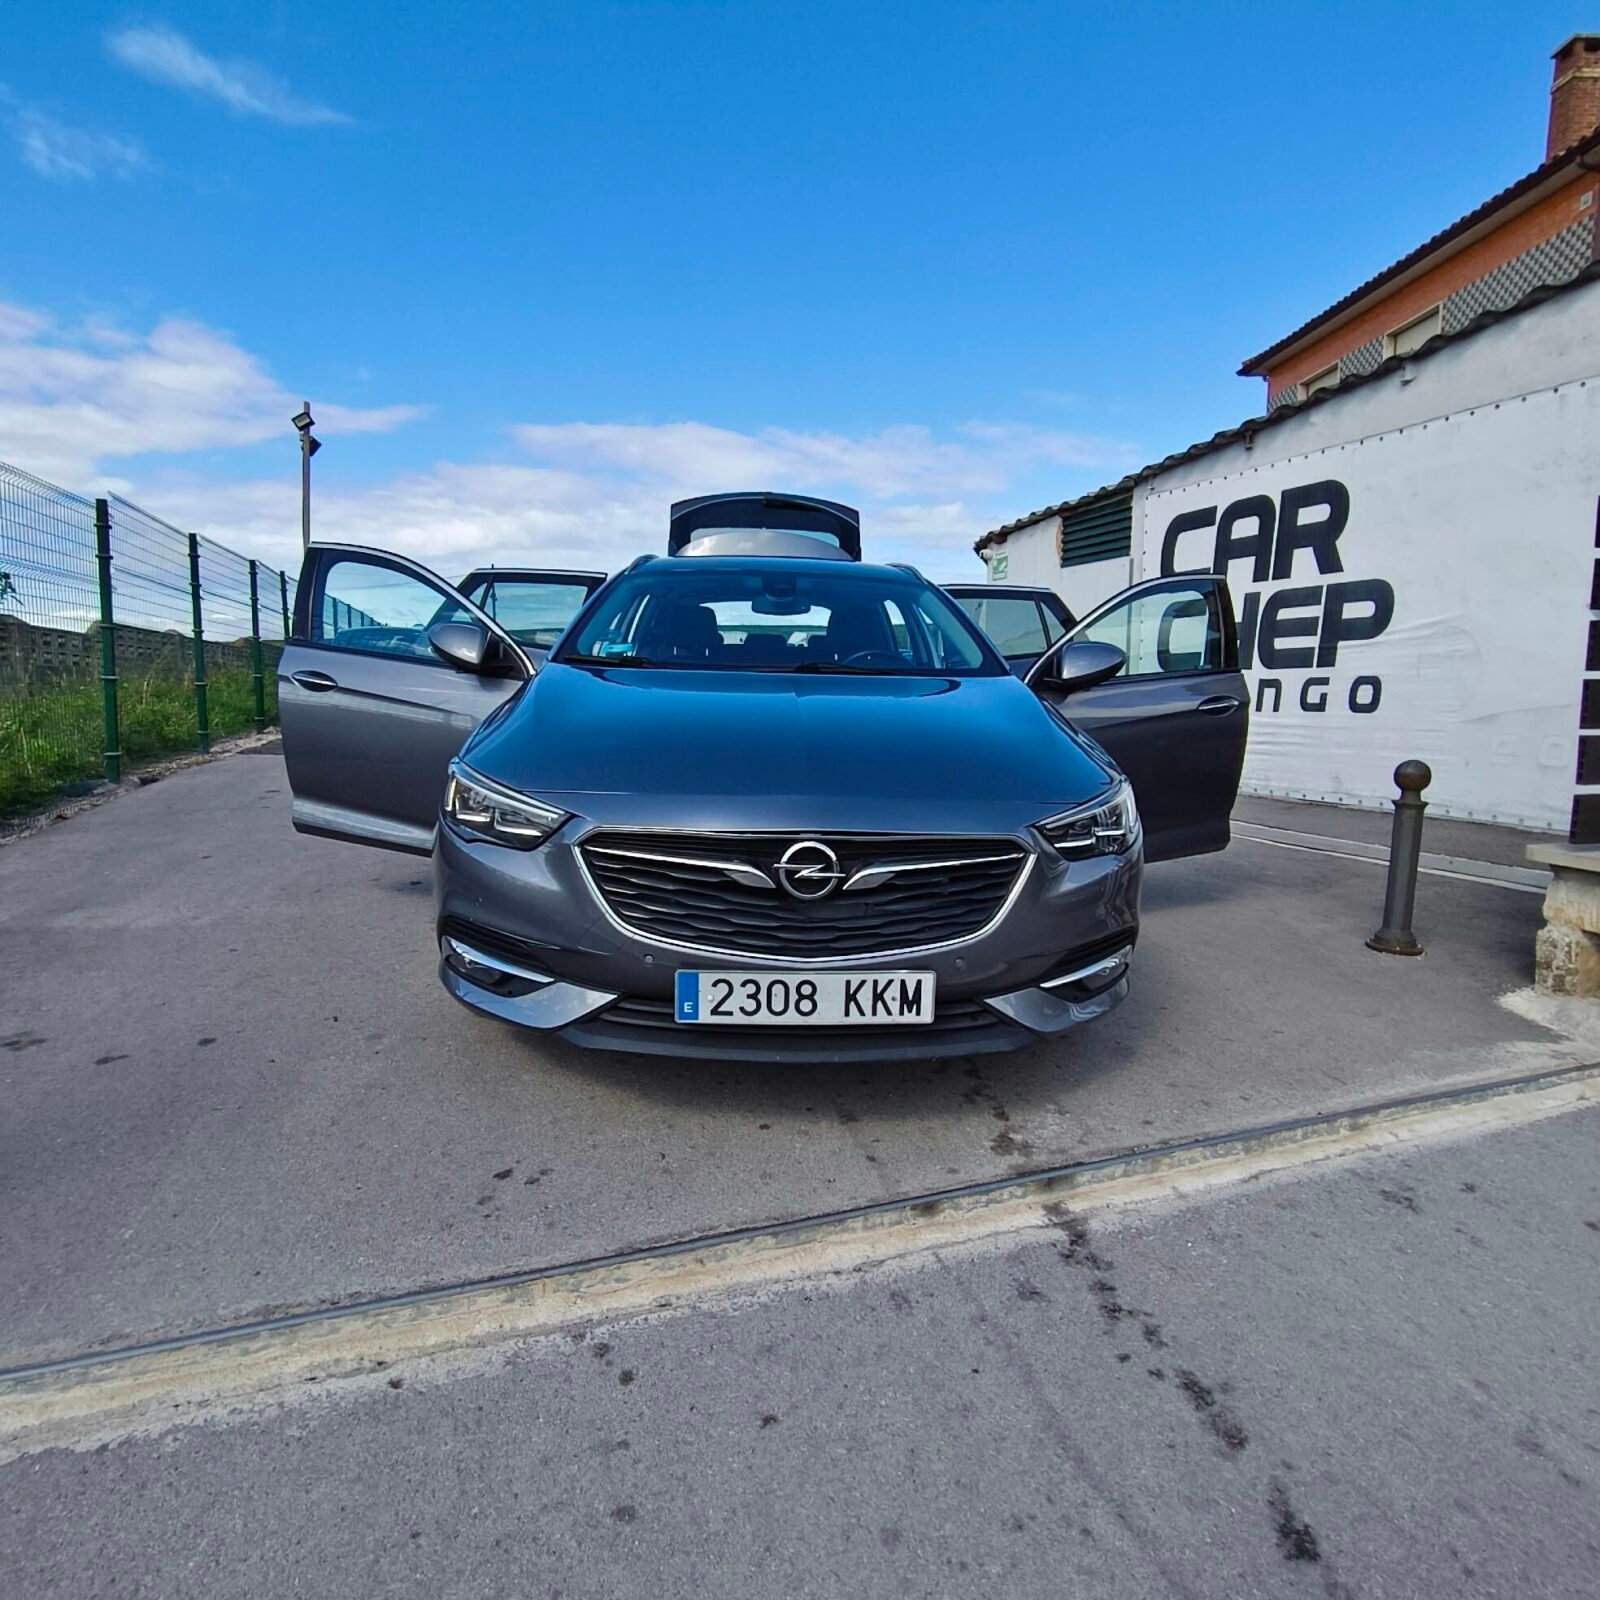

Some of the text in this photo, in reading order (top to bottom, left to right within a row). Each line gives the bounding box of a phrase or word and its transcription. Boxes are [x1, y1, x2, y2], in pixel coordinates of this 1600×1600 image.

[1160, 479, 1350, 583] CAR
[683, 1001, 694, 1013] E
[710, 978, 923, 1017] 2308 KKM
